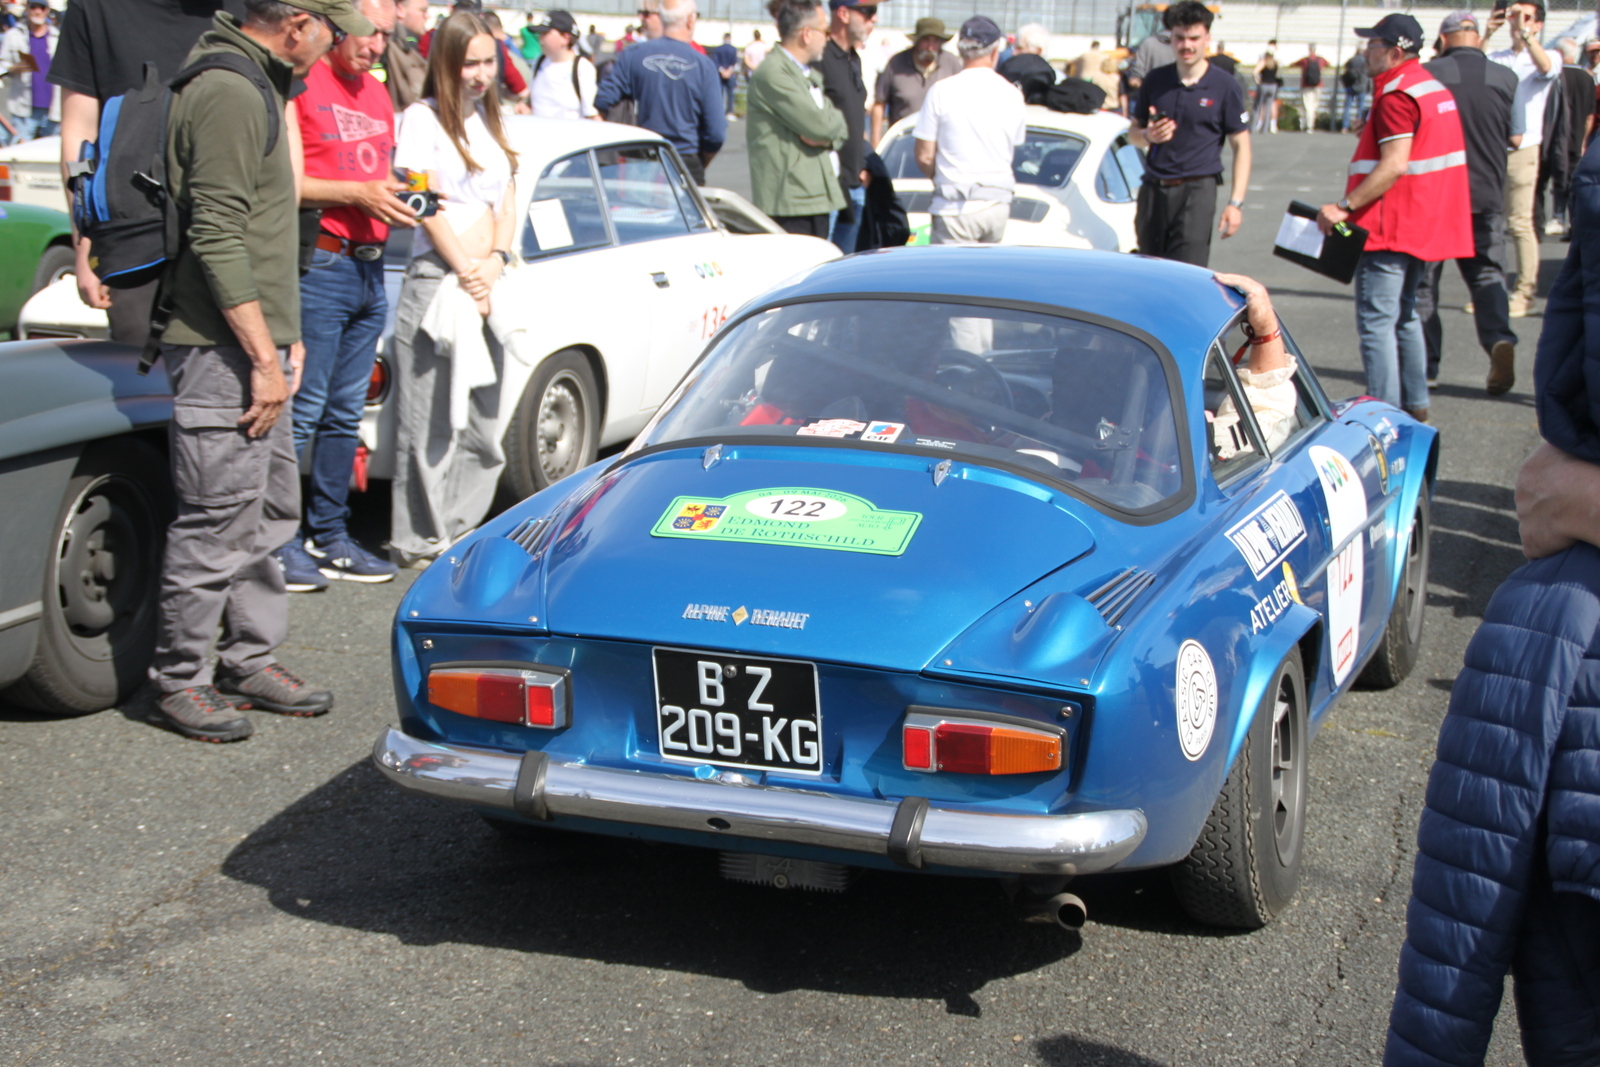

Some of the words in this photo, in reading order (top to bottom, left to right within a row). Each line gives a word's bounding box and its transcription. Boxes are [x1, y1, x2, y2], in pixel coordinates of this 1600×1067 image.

[769, 498, 827, 517] 122
[726, 516, 810, 530] EDMOND
[720, 527, 747, 537] DE
[751, 527, 875, 546] ROTHSCHILD
[682, 603, 730, 623] ALPINE
[749, 608, 810, 630] RENAULT
[1250, 580, 1293, 635] ATELIER
[1187, 652, 1202, 667] CAR
[1180, 667, 1193, 745] CLASSIC
[661, 704, 819, 765] 209-KG
